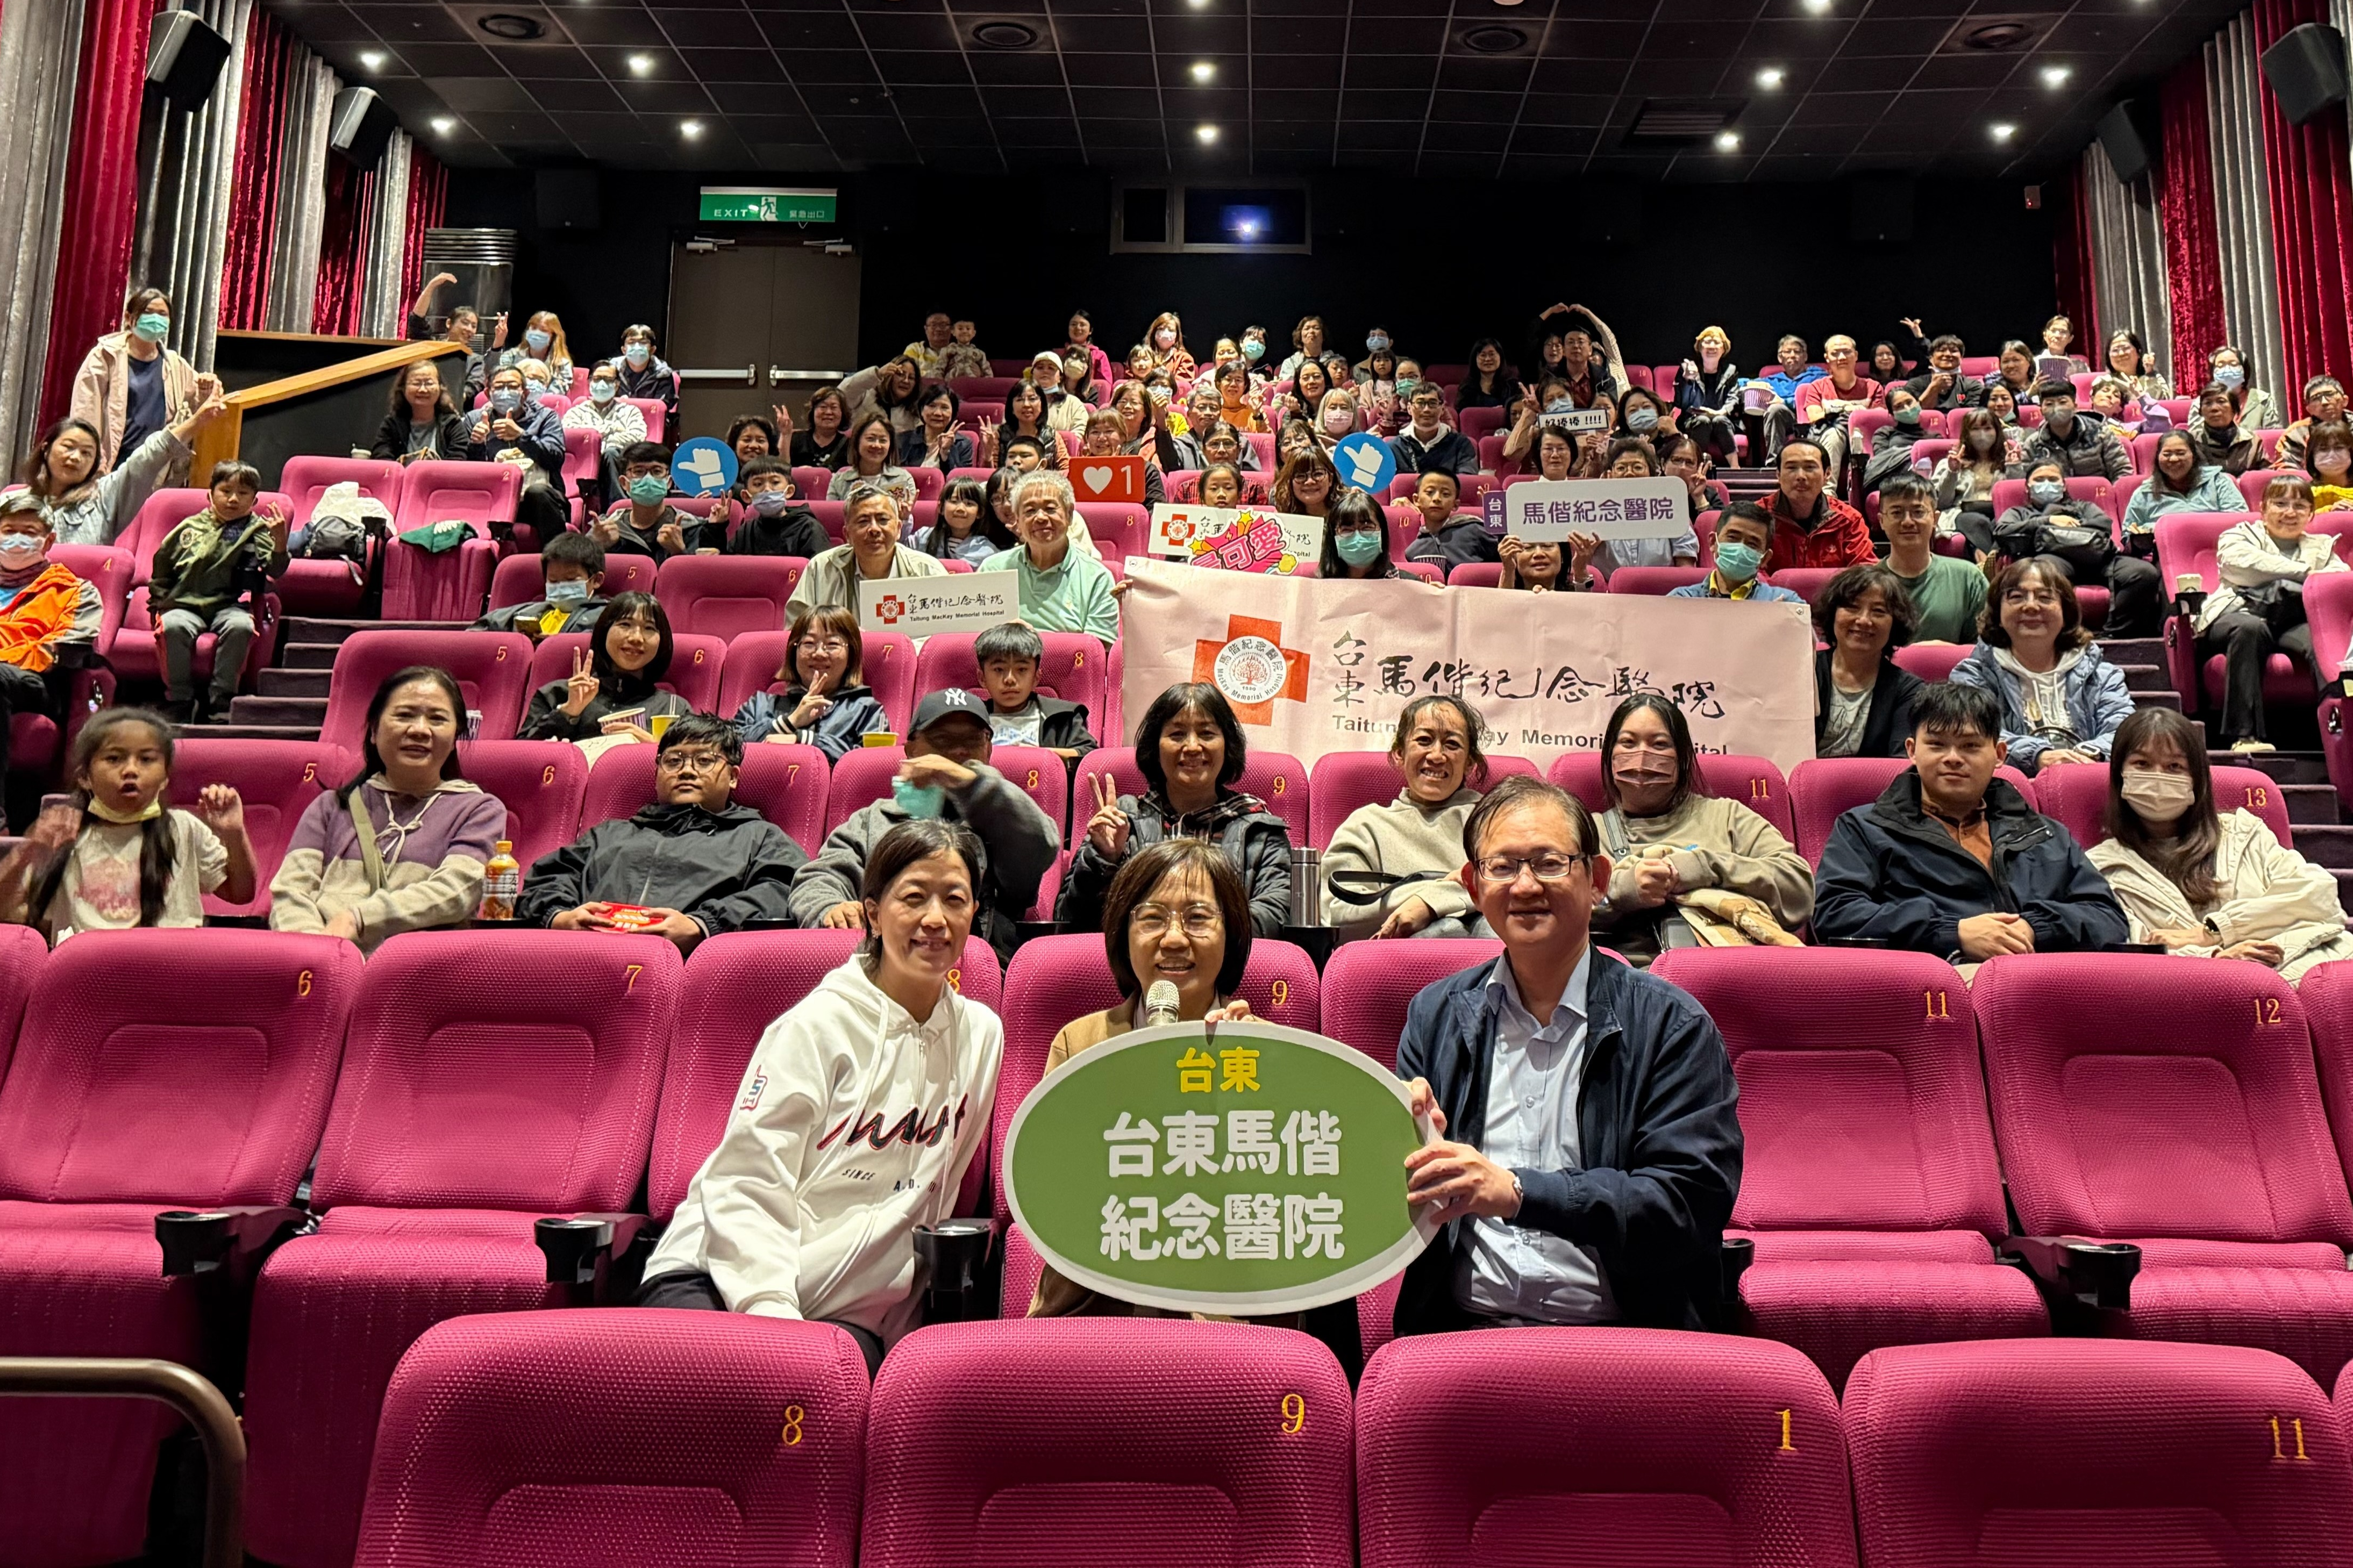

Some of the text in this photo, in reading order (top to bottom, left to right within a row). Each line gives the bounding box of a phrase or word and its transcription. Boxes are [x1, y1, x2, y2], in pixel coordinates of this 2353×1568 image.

[789, 210, 824, 218] 緊急出口
[651, 405, 657, 413] 2
[1930, 417, 1938, 426] 12
[583, 434, 589, 443] 2
[384, 468, 390, 478] 1
[502, 471, 510, 482] 2
[1121, 465, 1131, 495] 1
[2096, 487, 2106, 497] 12
[1126, 515, 1133, 526] 8
[1488, 498, 1503, 527] 台東
[1523, 496, 1674, 525] 馬偕紀念醫院
[1399, 517, 1409, 527] 10
[103, 557, 112, 571] 4
[627, 566, 637, 579] 5
[789, 569, 796, 582] 6
[496, 646, 508, 662] 5
[694, 648, 704, 664] 6
[883, 644, 894, 661] 7
[1075, 652, 1084, 667] 8
[1333, 630, 1367, 708] 台東
[945, 688, 967, 706] NY
[1231, 690, 1263, 701] Memorial
[1265, 674, 1284, 696] Hospital
[1332, 715, 1397, 733] Taitun
[1522, 729, 1603, 749] Memori
[303, 763, 317, 782] 5
[543, 765, 555, 785] 6
[788, 763, 801, 785] 7
[1027, 770, 1039, 789] 8
[1274, 776, 1286, 796] 9
[1751, 779, 1769, 799] 11
[2245, 787, 2267, 807] 13
[298, 970, 313, 997] 6
[626, 964, 643, 993] 7
[947, 968, 961, 993] 8
[1272, 980, 1288, 1006] 9
[1924, 991, 1950, 1018] 11
[2254, 998, 2281, 1025] 12
[1176, 1046, 1260, 1093] 台東
[1103, 1109, 1342, 1178] 台東馬偕
[842, 1169, 876, 1180] SINCE
[1100, 1192, 1345, 1262] 紀念醫院
[1281, 1393, 1305, 1434] 9
[782, 1405, 804, 1446] 8
[1775, 1408, 1797, 1451] 1
[2268, 1416, 2309, 1460] 11
